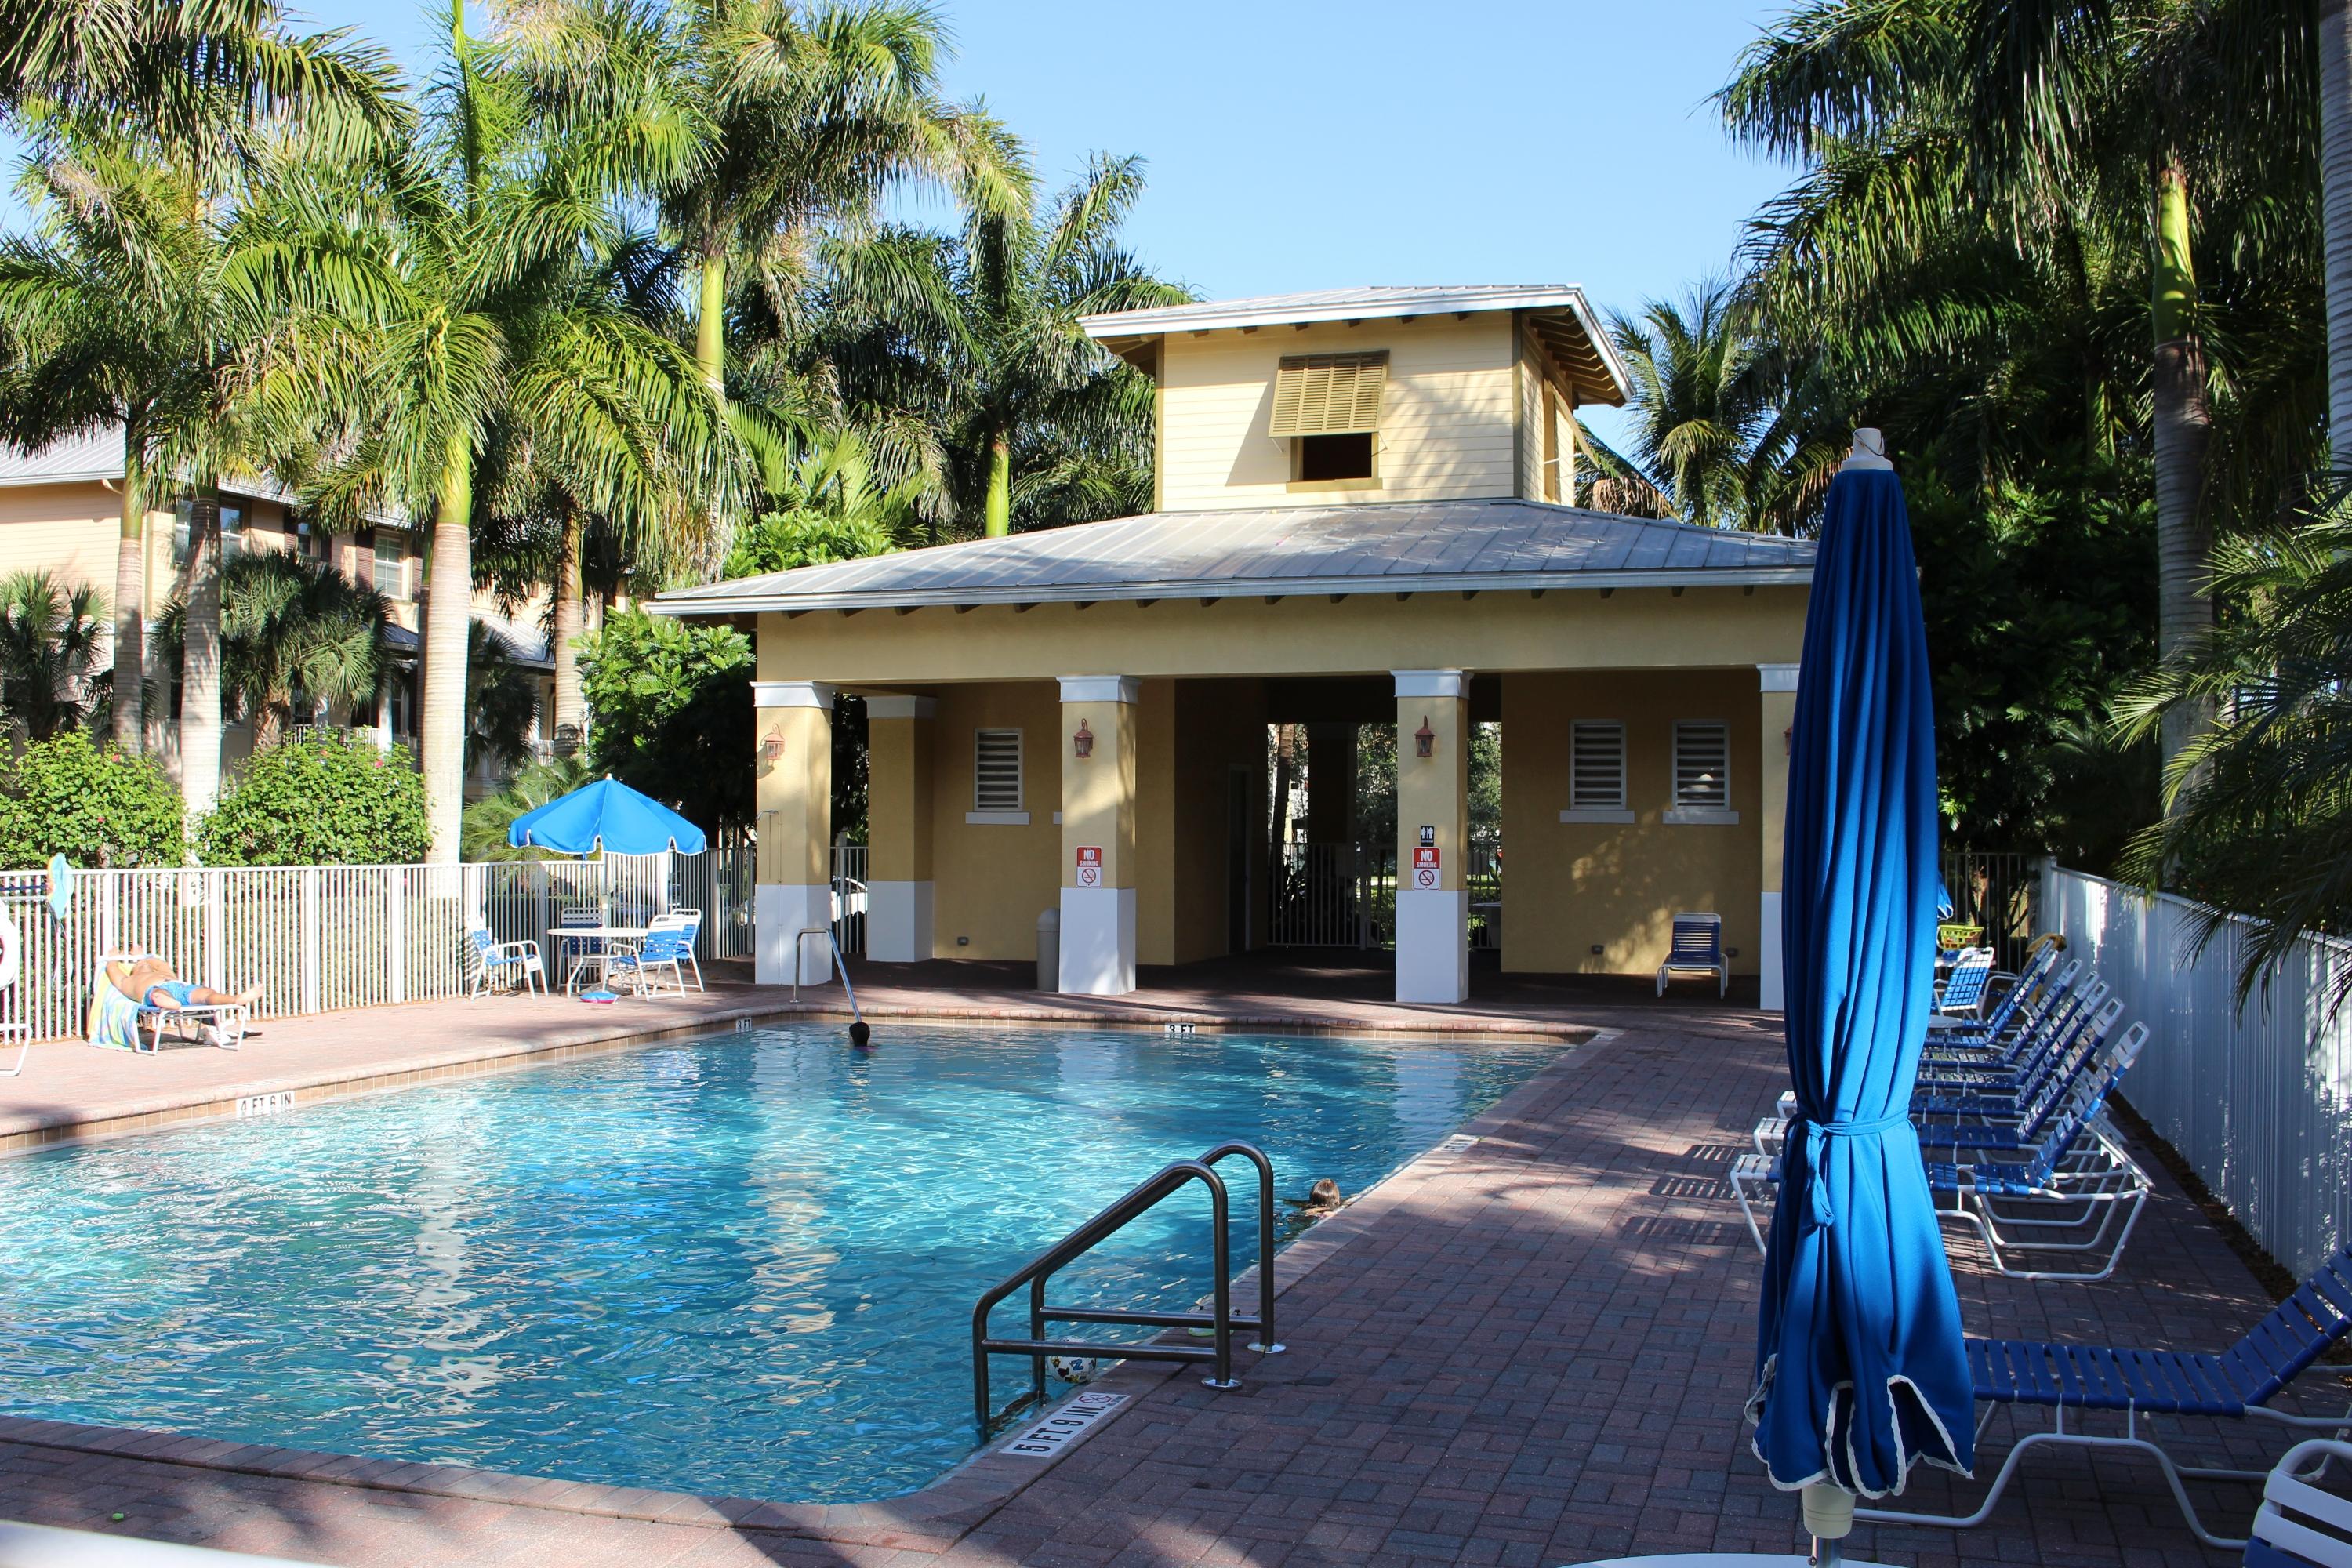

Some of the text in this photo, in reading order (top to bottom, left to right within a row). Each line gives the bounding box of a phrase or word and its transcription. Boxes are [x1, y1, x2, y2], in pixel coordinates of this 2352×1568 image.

[1083, 849, 1095, 860] NO
[1421, 850, 1433, 862] NO
[1181, 1024, 1194, 1033] FT
[252, 1097, 264, 1109] FT
[281, 1092, 292, 1105] IN
[1013, 1443, 1051, 1452] 5
